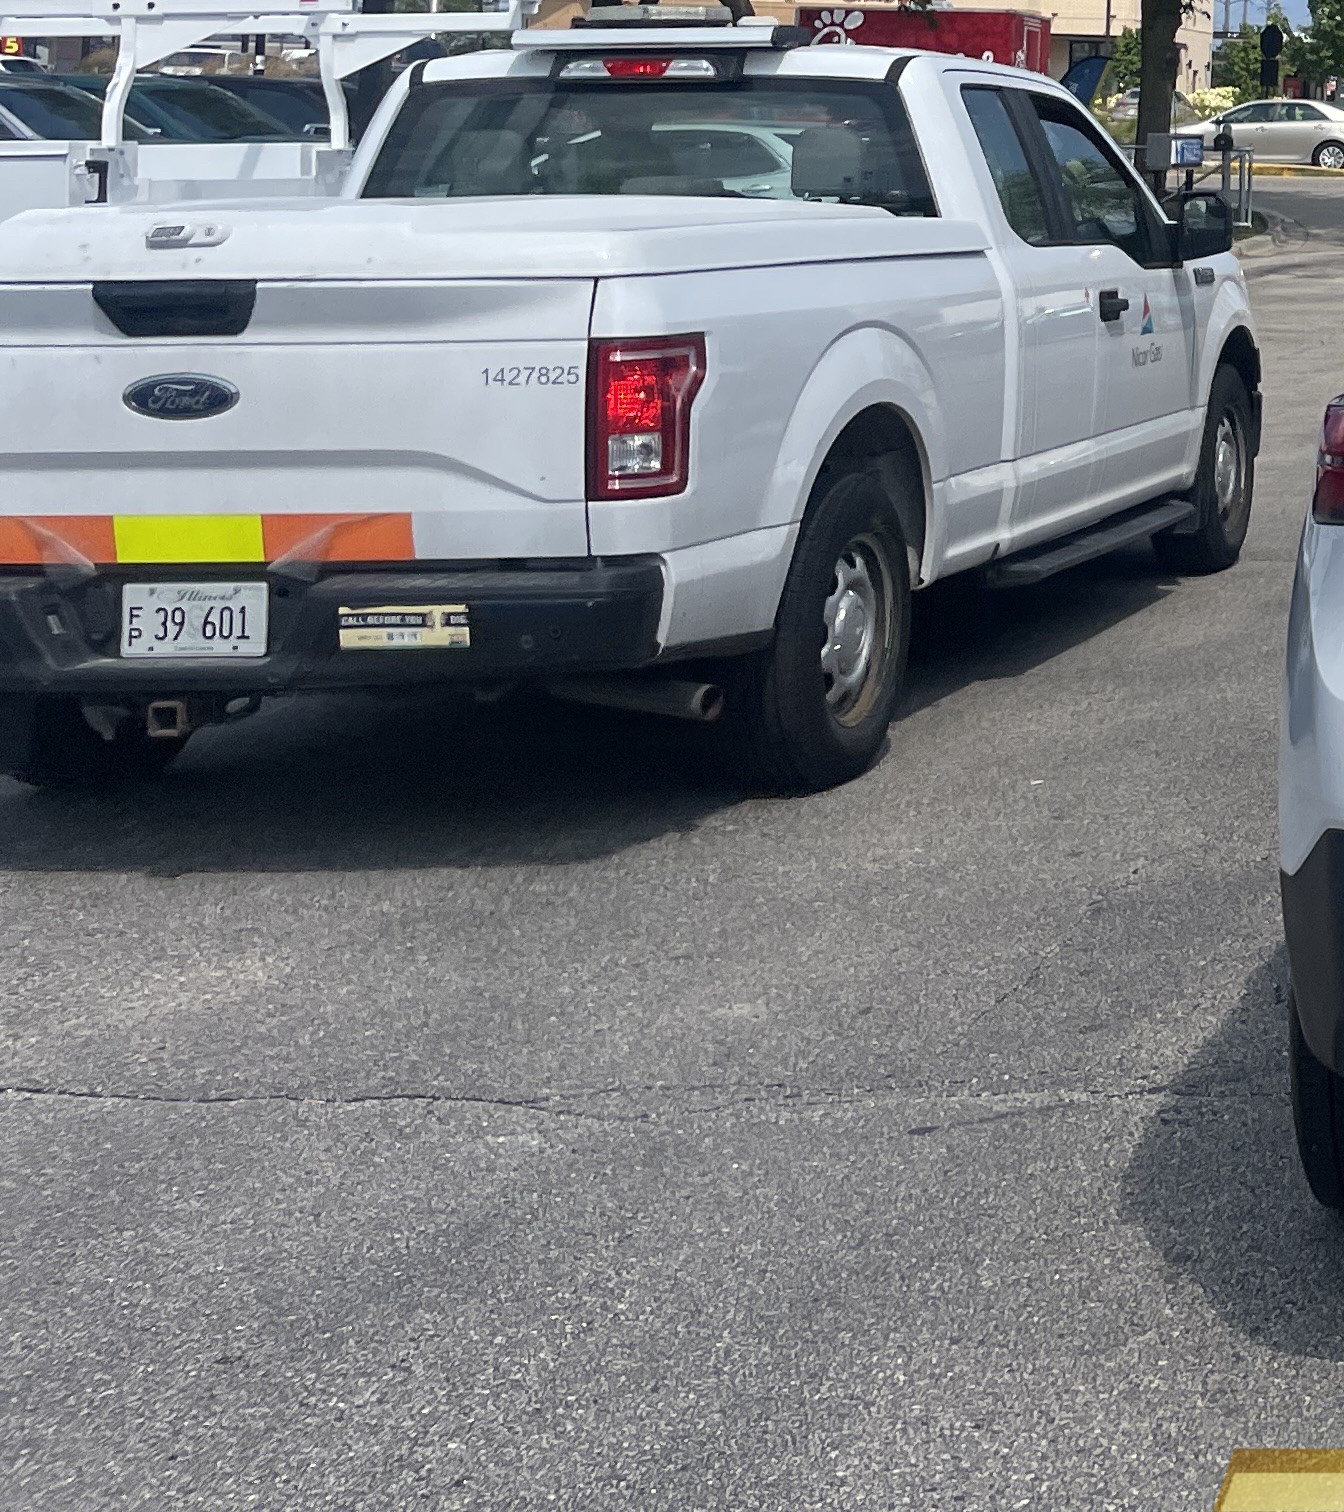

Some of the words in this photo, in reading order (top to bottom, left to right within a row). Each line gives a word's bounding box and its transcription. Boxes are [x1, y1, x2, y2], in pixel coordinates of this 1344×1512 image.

[481, 366, 580, 386] 1427825
[147, 384, 212, 411] Ford
[154, 606, 186, 641] 39
[202, 605, 251, 640] 601
